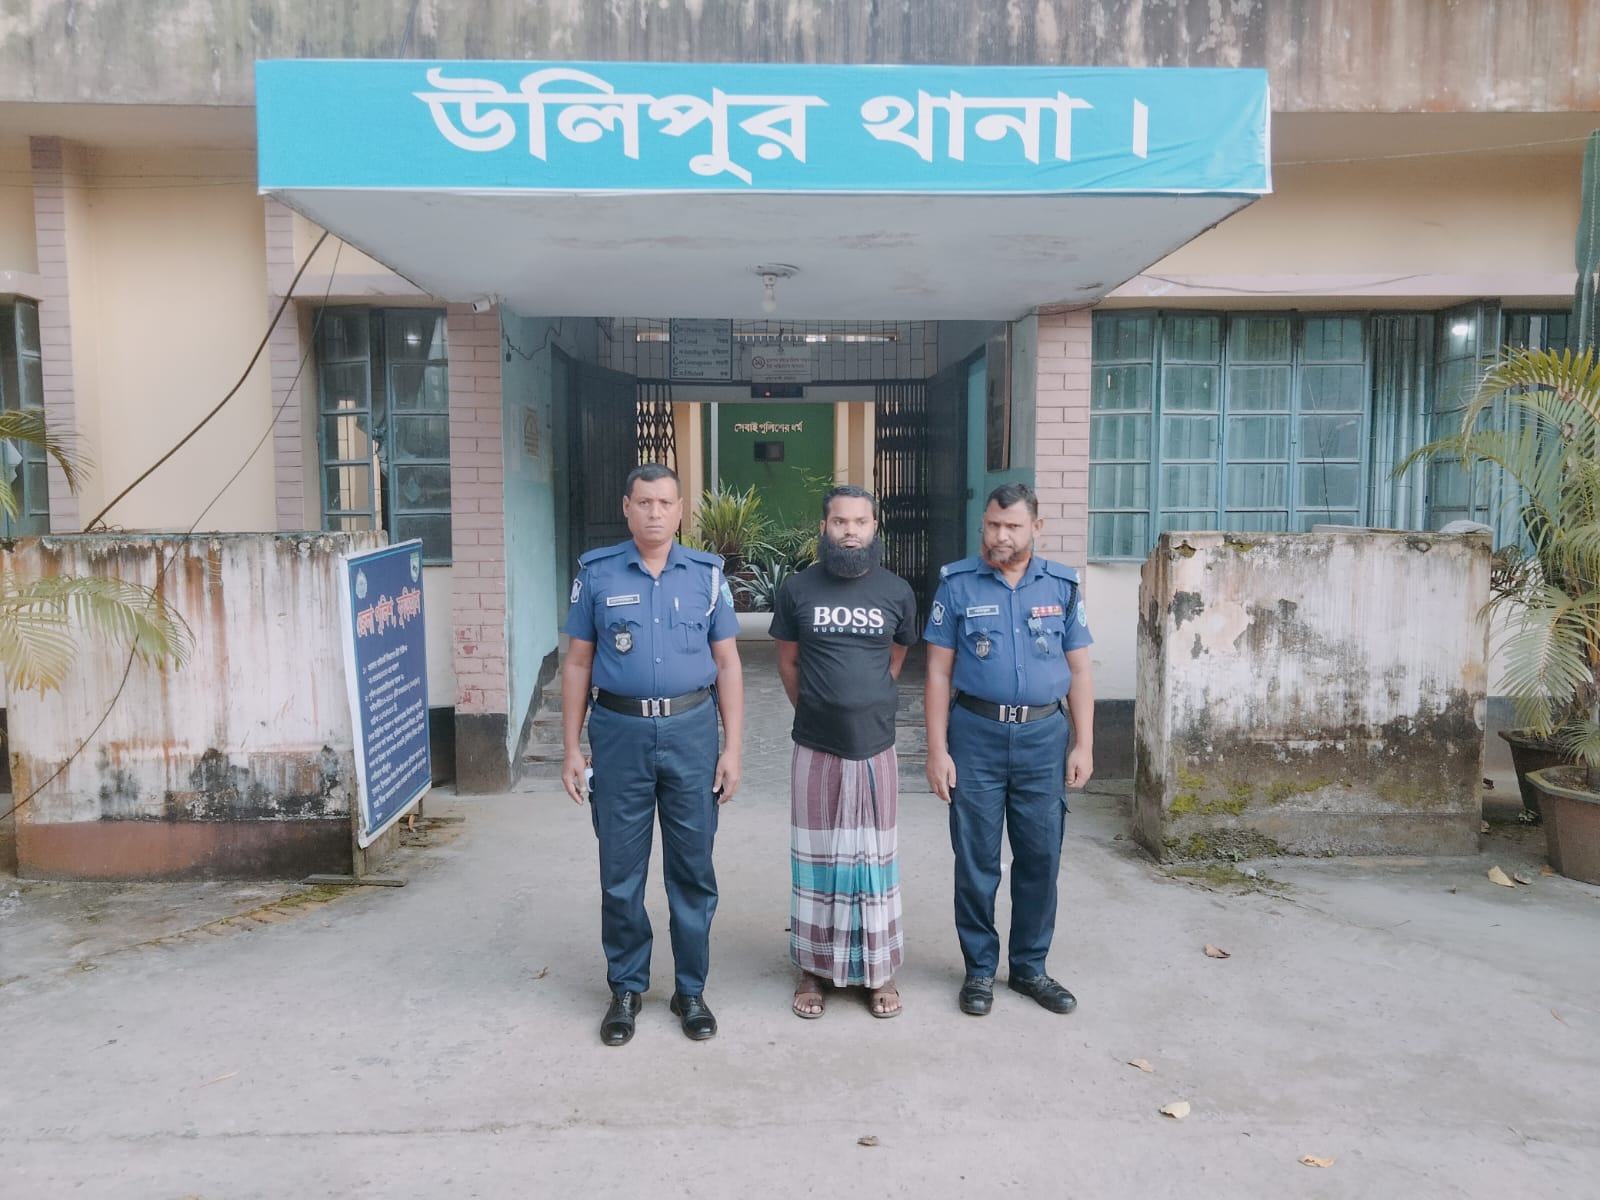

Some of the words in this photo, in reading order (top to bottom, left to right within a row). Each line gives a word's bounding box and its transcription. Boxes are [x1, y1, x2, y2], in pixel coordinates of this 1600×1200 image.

[412, 67, 830, 185] উলিপুর
[860, 89, 1094, 165] থানা
[759, 420, 790, 435] পুলিশের
[812, 606, 885, 628] BOSS
[851, 627, 884, 635] BOSS
